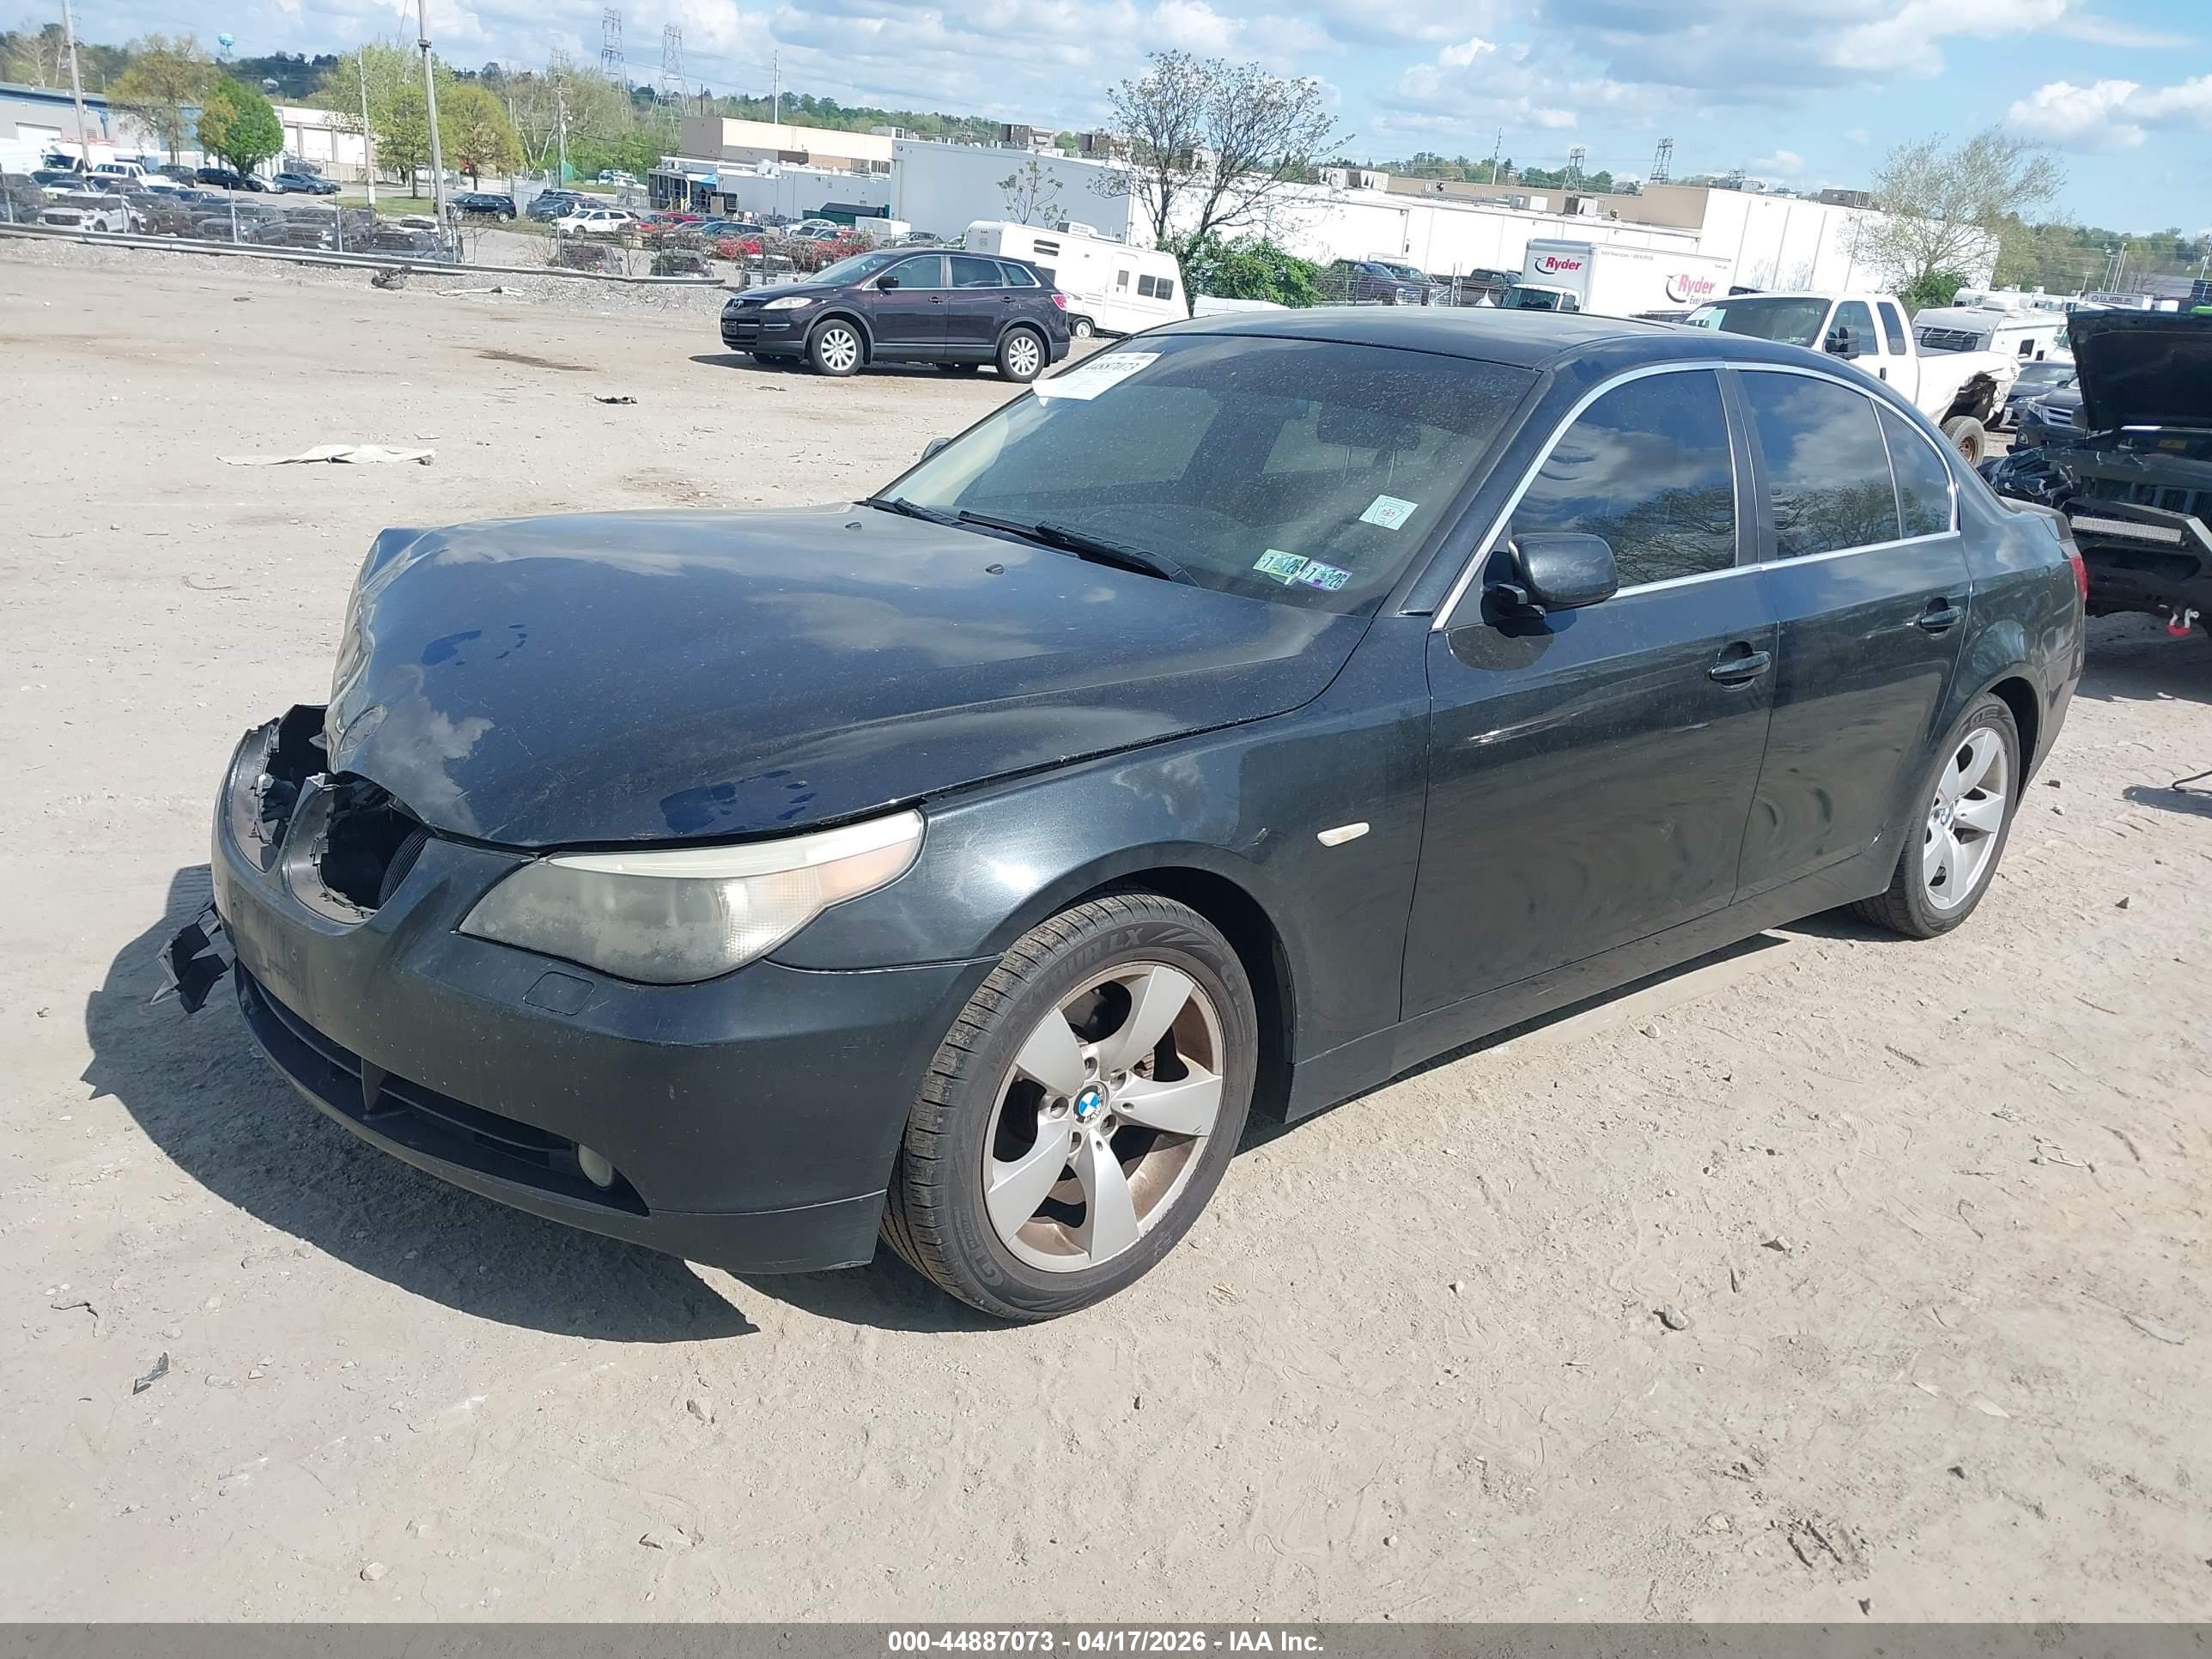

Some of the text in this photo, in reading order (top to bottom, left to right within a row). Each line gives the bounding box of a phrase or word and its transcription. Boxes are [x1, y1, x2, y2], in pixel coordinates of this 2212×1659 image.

[1546, 256, 1583, 271] Ryder
[1678, 274, 1717, 297] Ryder
[1263, 556, 1304, 574] 7 26
[1305, 567, 1347, 589] 7 26
